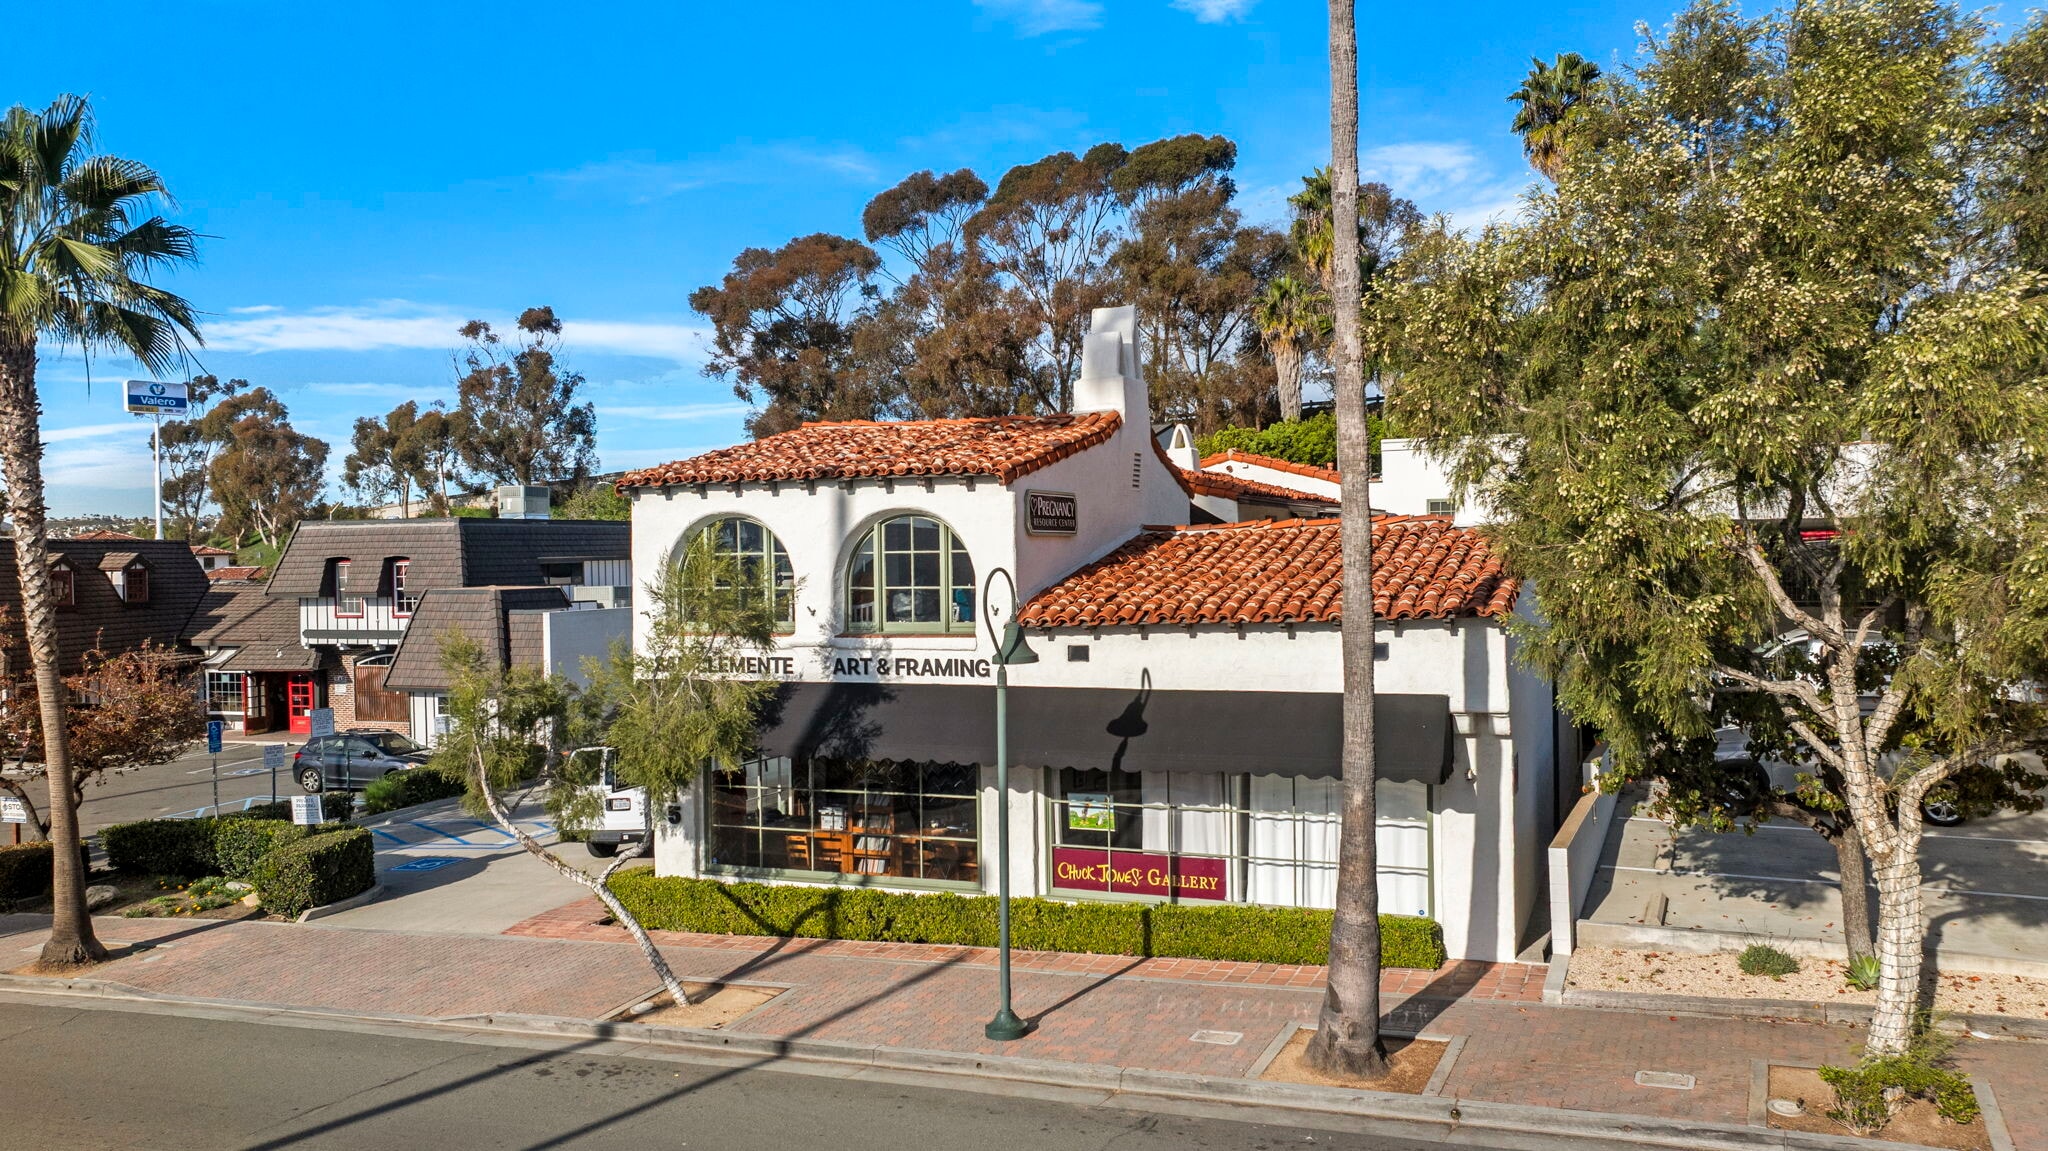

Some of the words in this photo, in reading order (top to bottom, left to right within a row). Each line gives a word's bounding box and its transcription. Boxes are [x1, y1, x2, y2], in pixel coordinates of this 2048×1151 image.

[140, 396, 176, 406] Valero
[1038, 497, 1075, 517] PREGNANCY
[1034, 518, 1058, 527] RESOURCE
[1058, 519, 1075, 527] CENTER
[833, 658, 873, 675] ART
[876, 658, 890, 675] &
[895, 658, 991, 678] FRAMING
[1147, 868, 1219, 890] GALLERY
